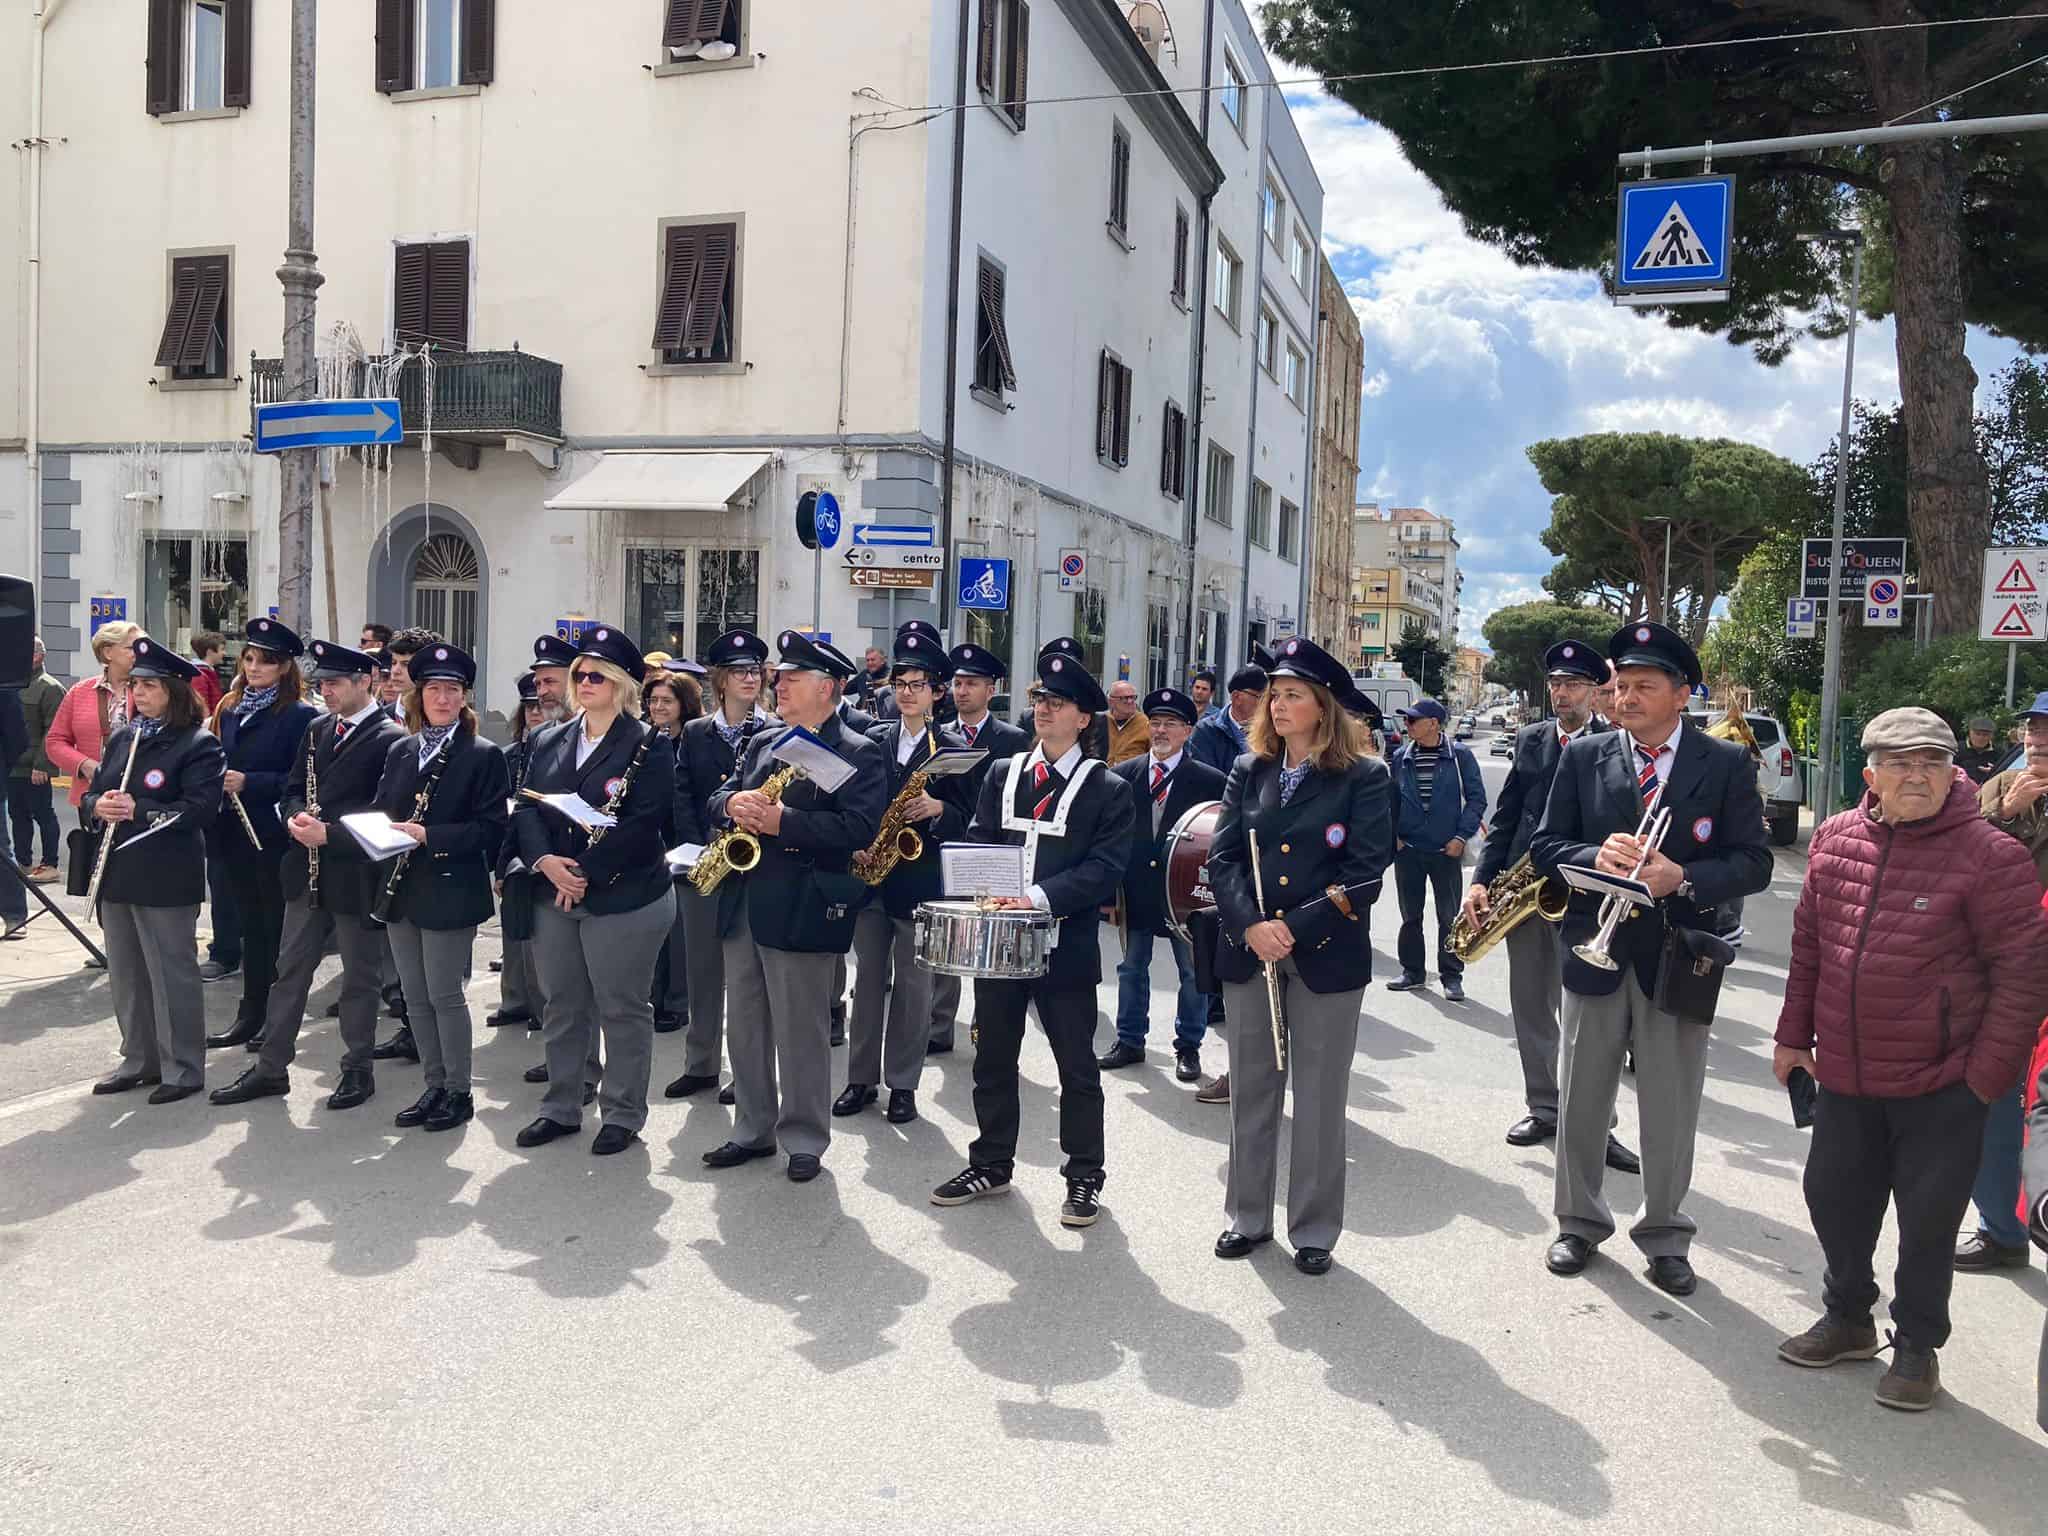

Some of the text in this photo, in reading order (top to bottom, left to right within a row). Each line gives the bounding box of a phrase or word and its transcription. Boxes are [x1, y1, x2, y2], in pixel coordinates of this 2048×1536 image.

[904, 554, 940, 563] centro
[1808, 554, 1900, 568] SUSI QUEEN
